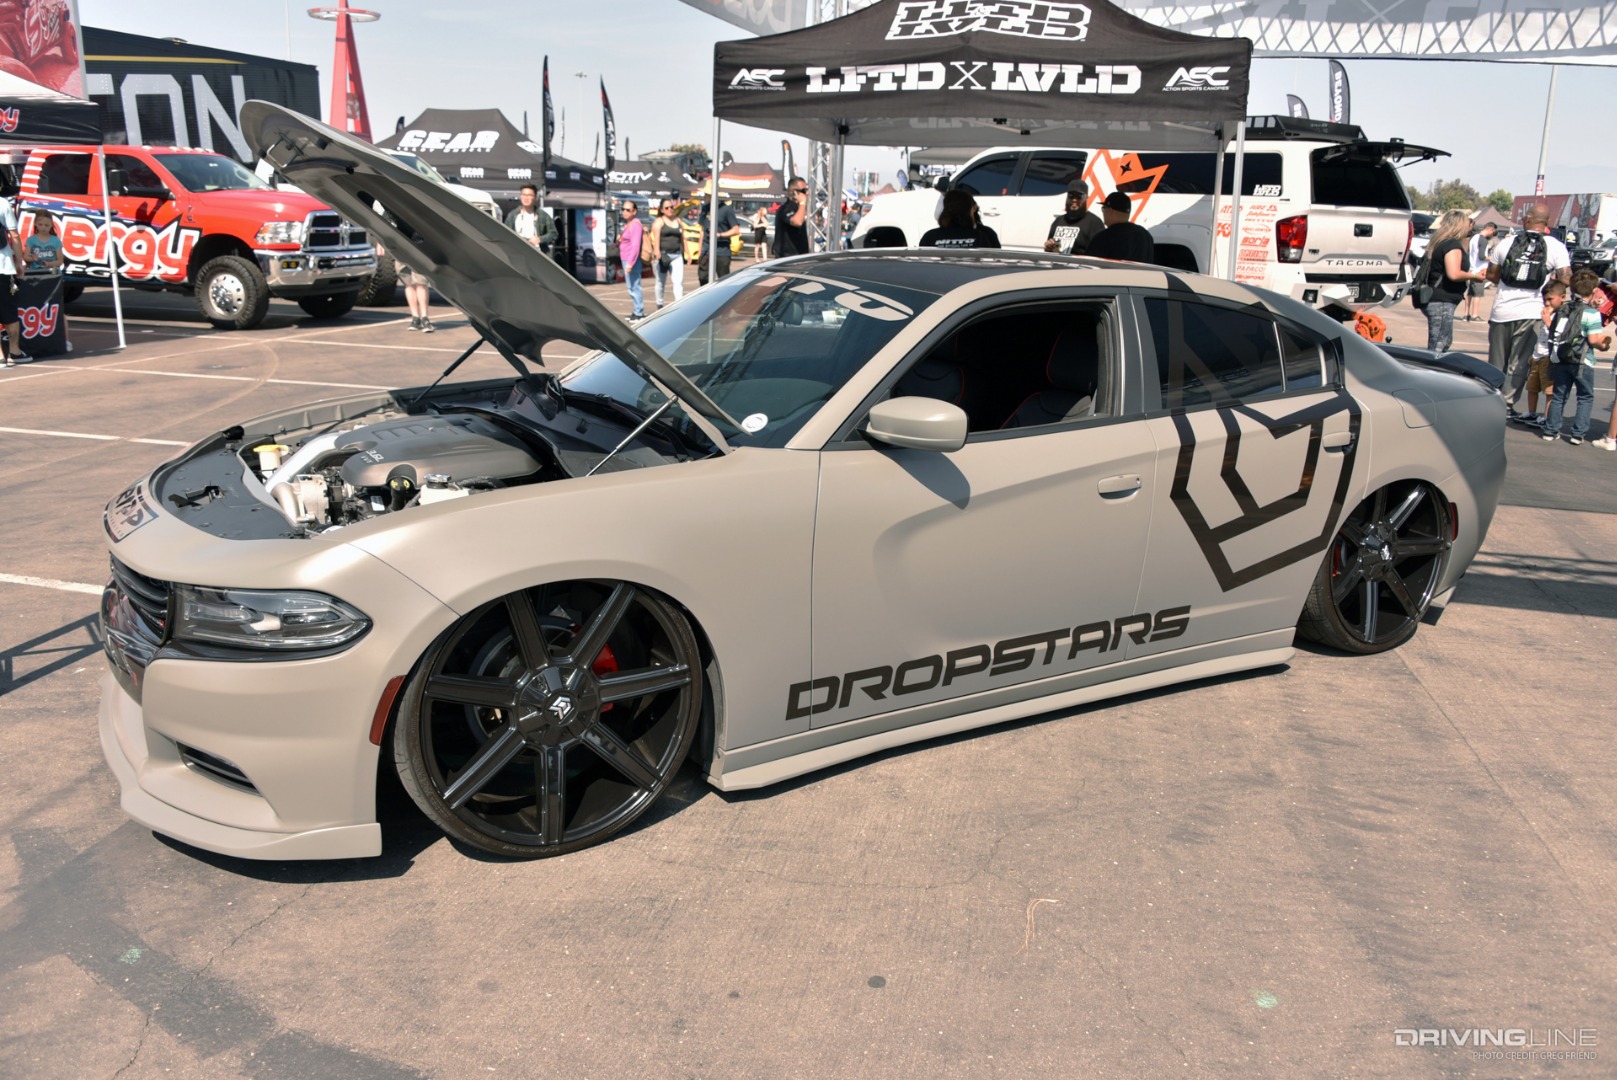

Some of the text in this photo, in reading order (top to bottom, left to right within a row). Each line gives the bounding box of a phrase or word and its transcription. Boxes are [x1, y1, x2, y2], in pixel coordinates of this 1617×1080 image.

[730, 68, 786, 86] ASC
[805, 61, 1142, 94] LFTD X LVLD
[1165, 66, 1231, 86] ASC
[399, 130, 500, 150] GEAR
[785, 604, 1191, 721] DROPSTARS
